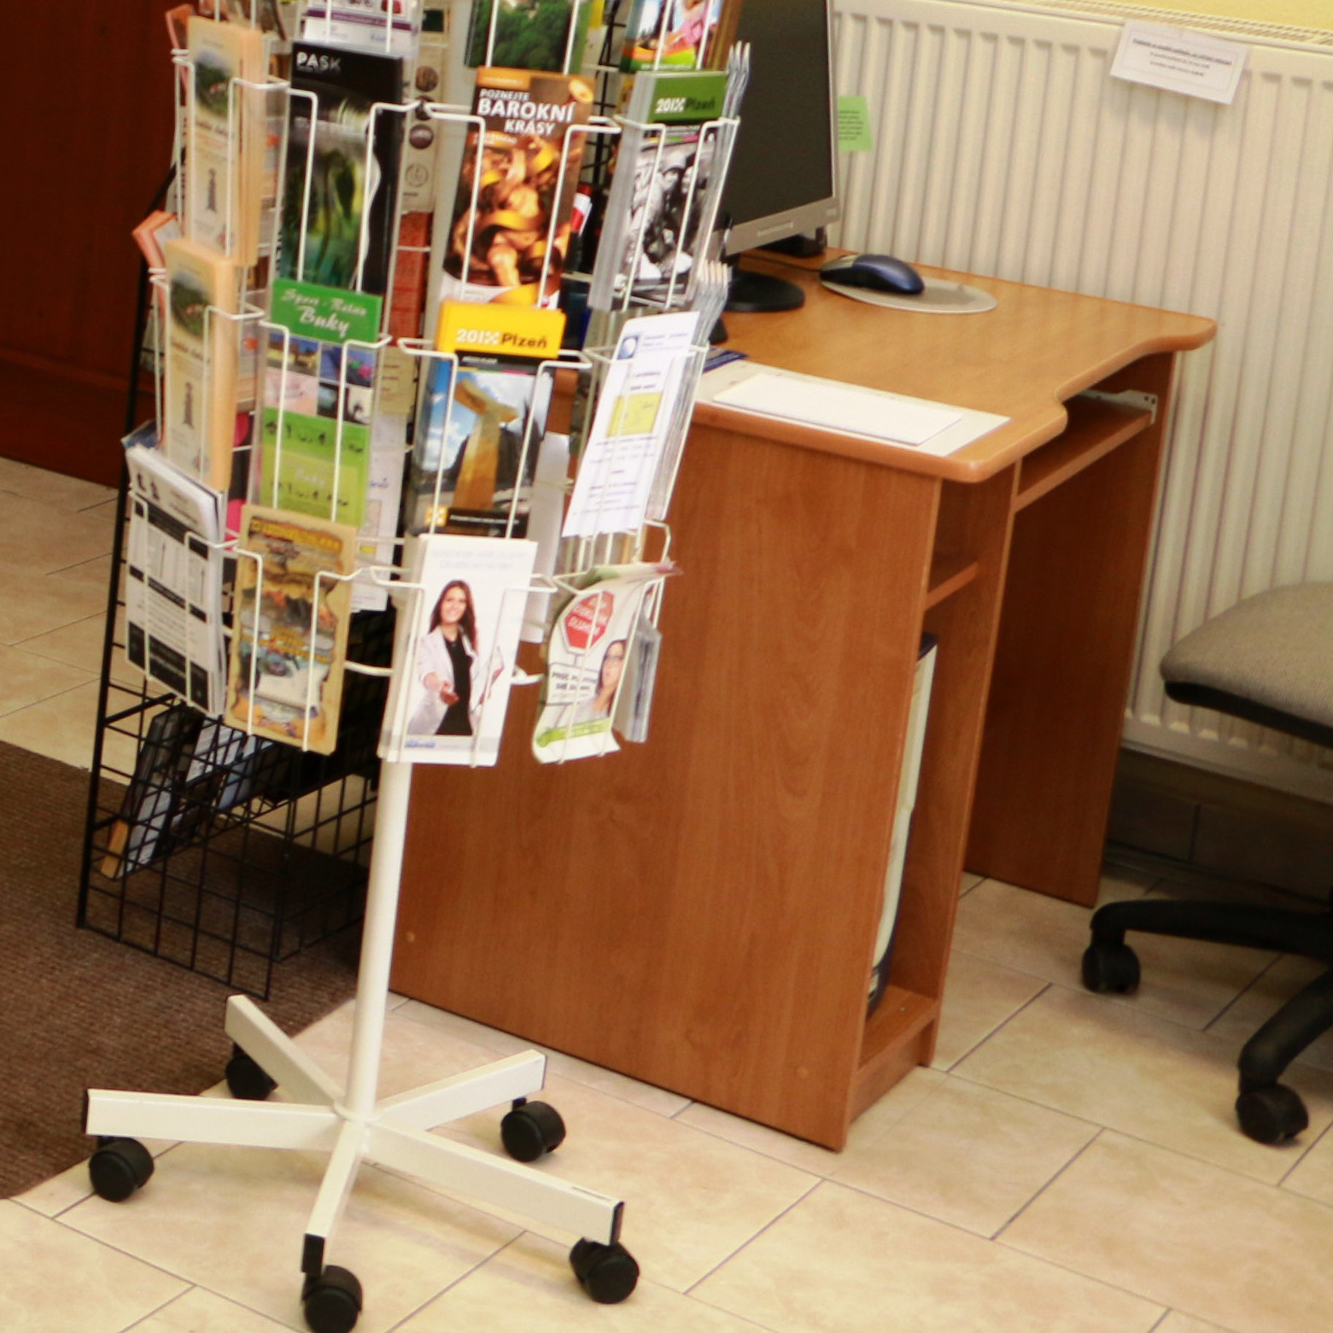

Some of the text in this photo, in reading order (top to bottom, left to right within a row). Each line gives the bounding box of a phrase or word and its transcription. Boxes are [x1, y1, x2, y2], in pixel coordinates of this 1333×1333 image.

[479, 88, 530, 102] POZNEJTE
[477, 98, 576, 123] BAROKNÍ
[504, 116, 555, 136] KRÁSY
[296, 305, 350, 339] Buky
